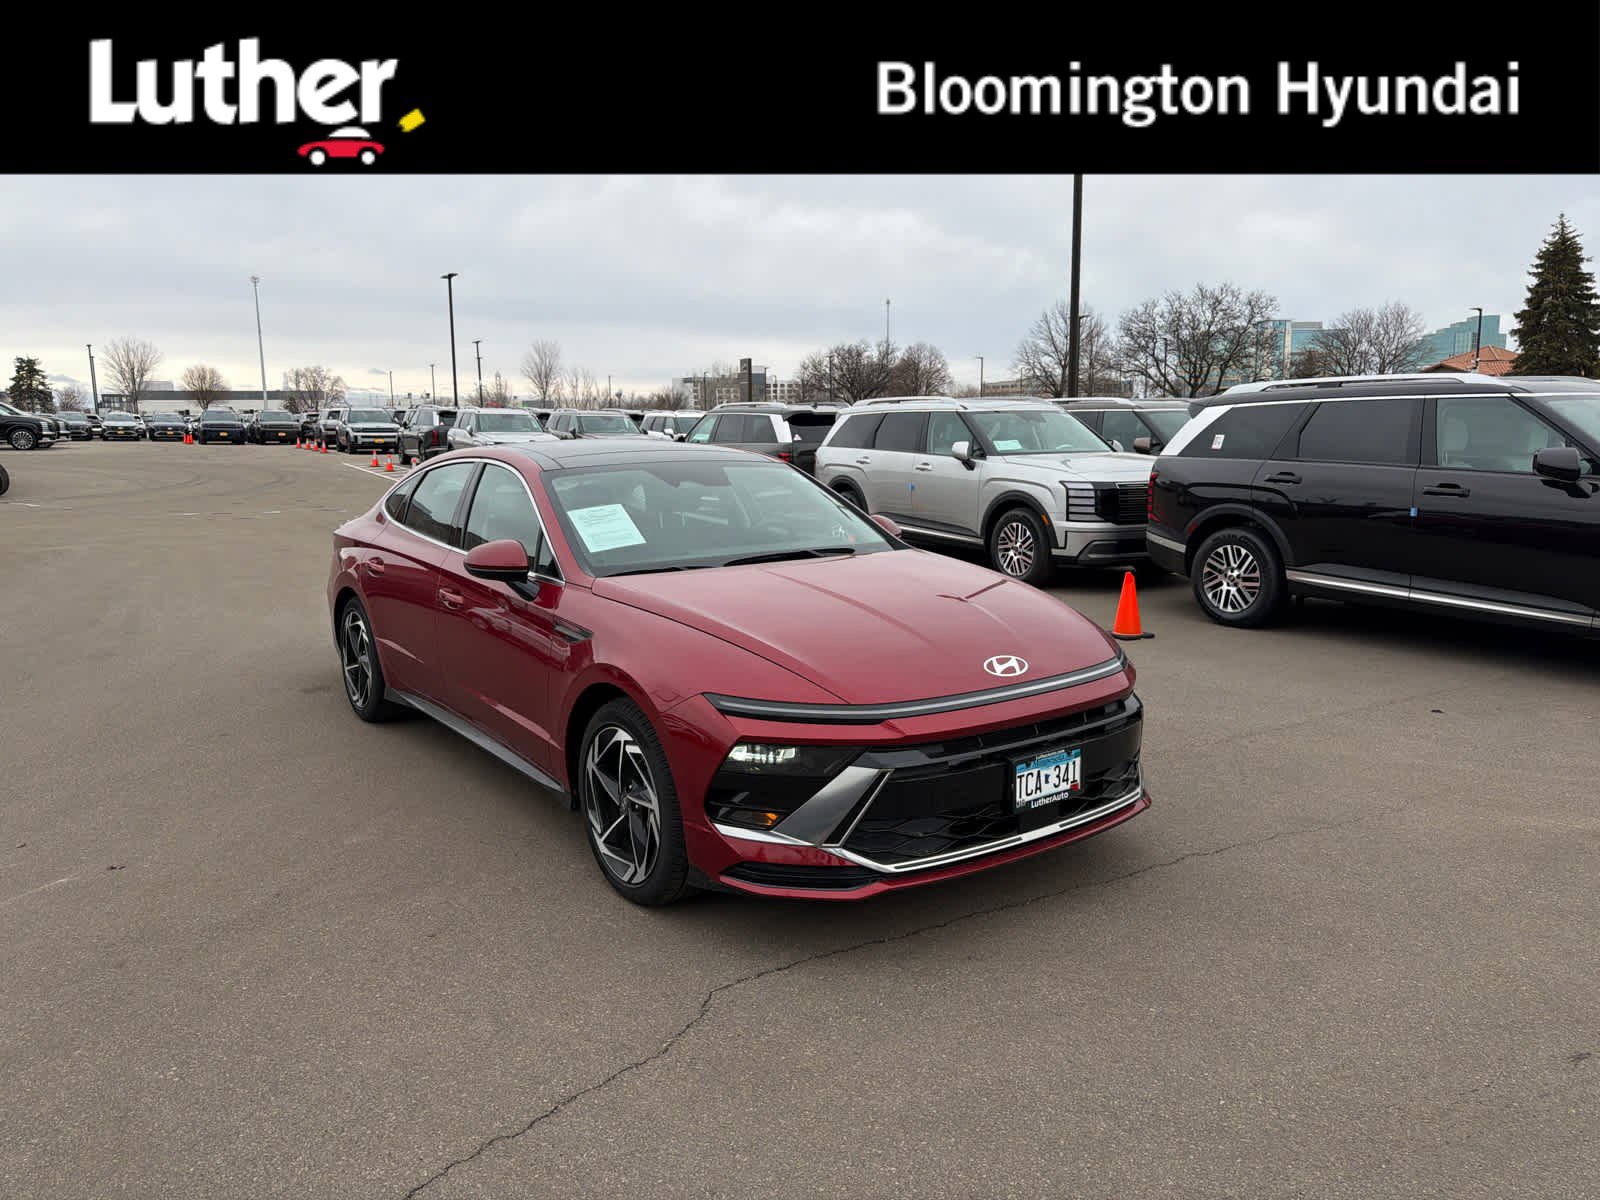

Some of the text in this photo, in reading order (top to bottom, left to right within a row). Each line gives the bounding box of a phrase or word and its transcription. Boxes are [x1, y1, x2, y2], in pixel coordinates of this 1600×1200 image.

[1017, 761, 1078, 799] TCA 341
[1030, 791, 1069, 808] LutherAuto
